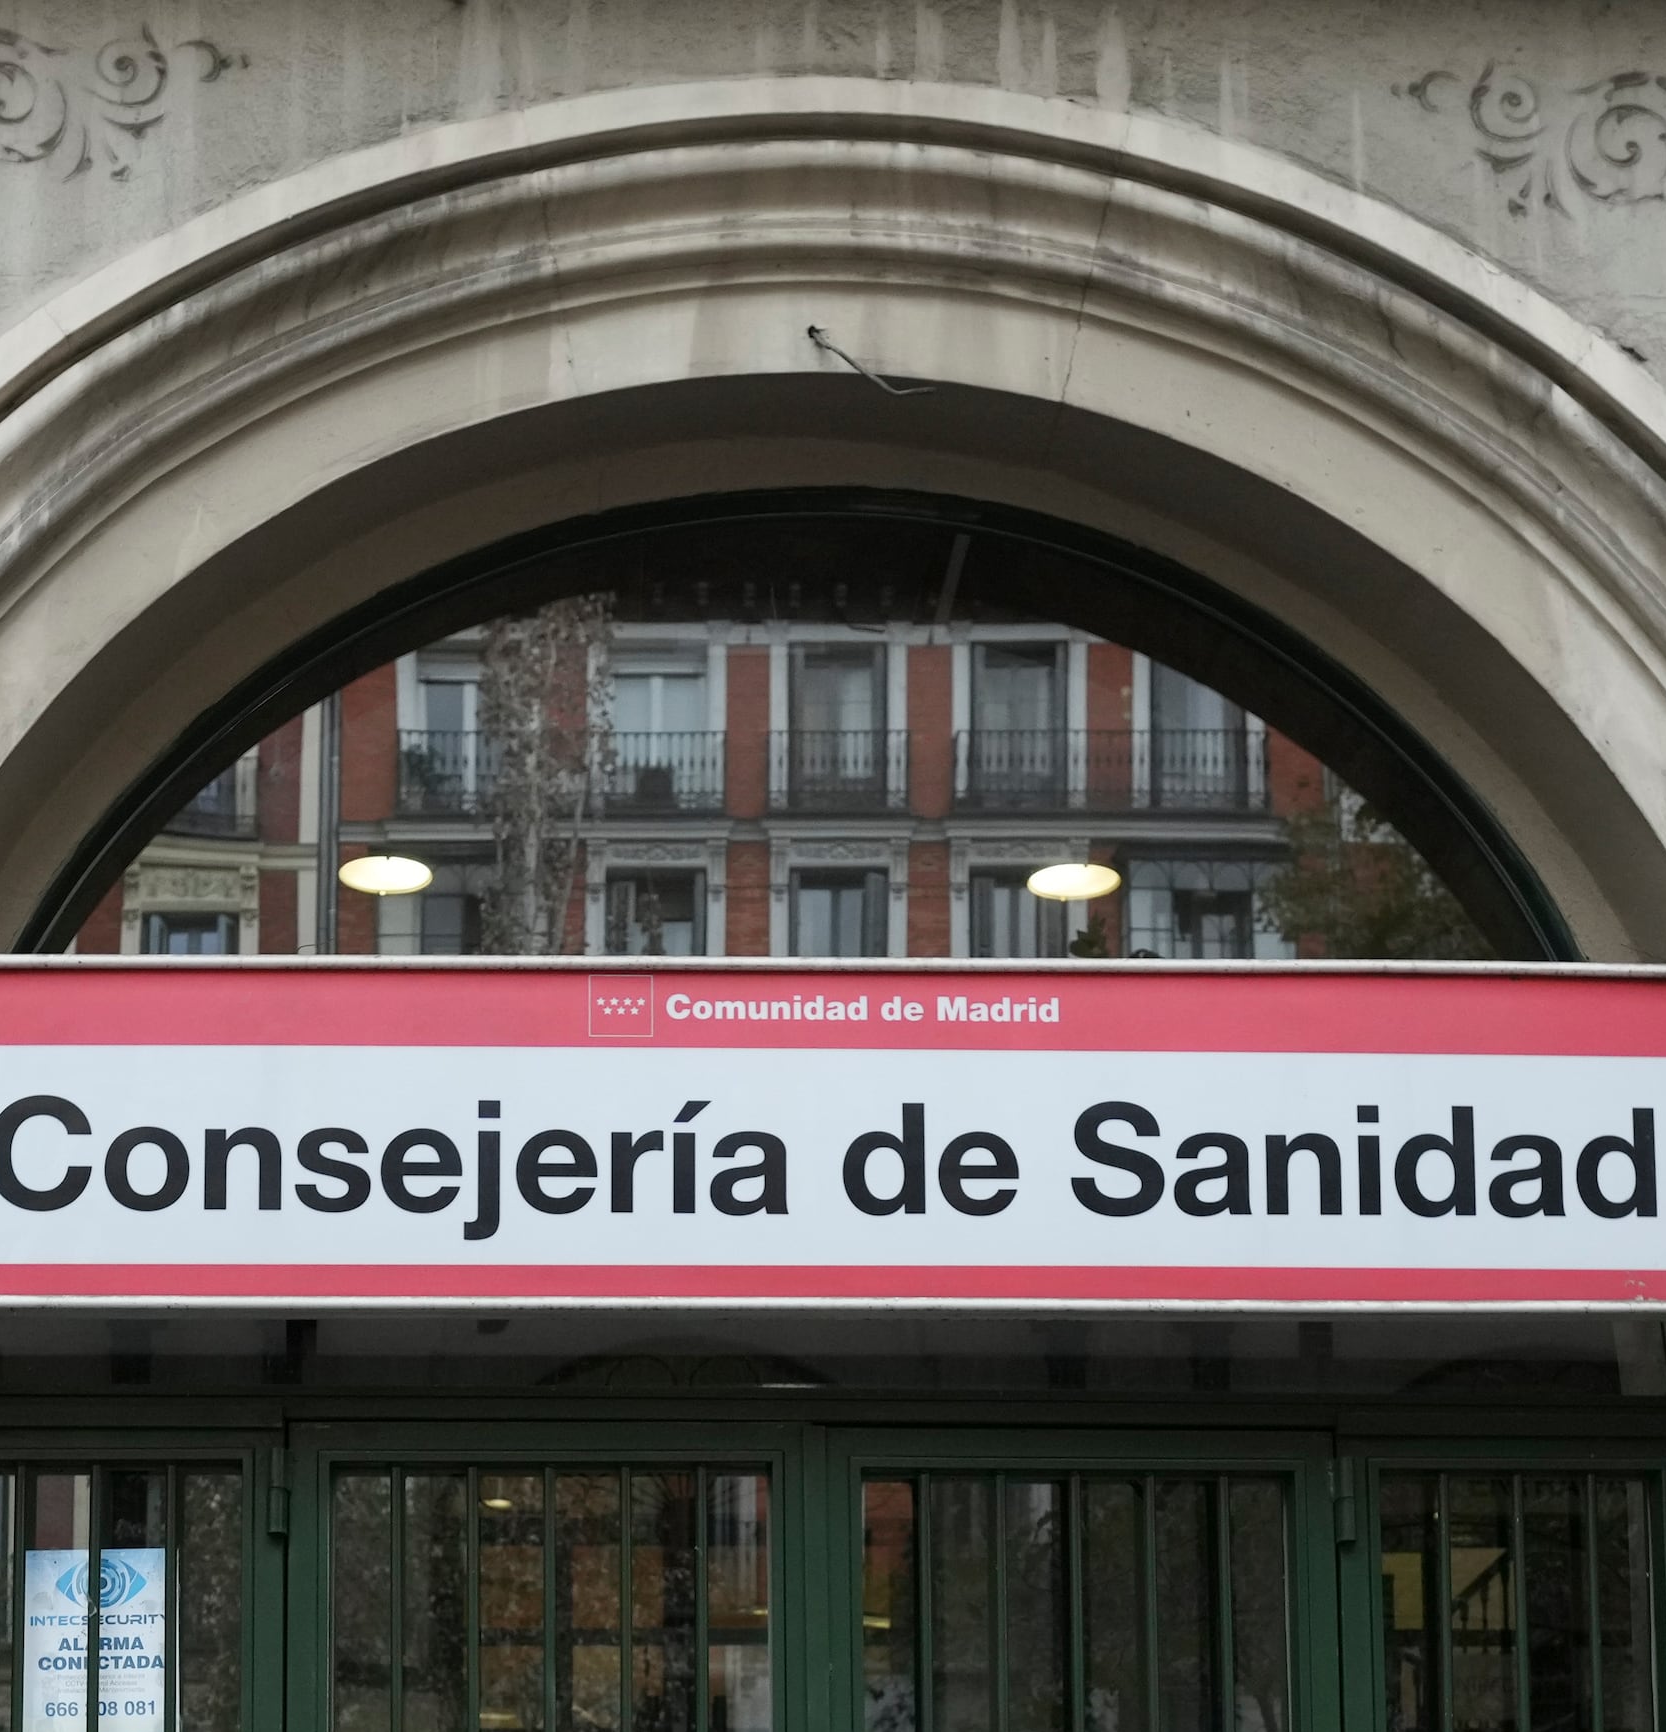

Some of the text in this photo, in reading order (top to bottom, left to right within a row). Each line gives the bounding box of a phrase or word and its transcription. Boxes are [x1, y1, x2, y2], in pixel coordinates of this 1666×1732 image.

[665, 993, 1060, 1022] Comunidad de Madrid
[842, 1103, 1020, 1217] de
[1071, 1101, 1658, 1218] Sanidad
[58, 1636, 144, 1651] ALRMA
[38, 1655, 164, 1671] CONCTADA
[45, 1700, 155, 1717] 666 08 081
